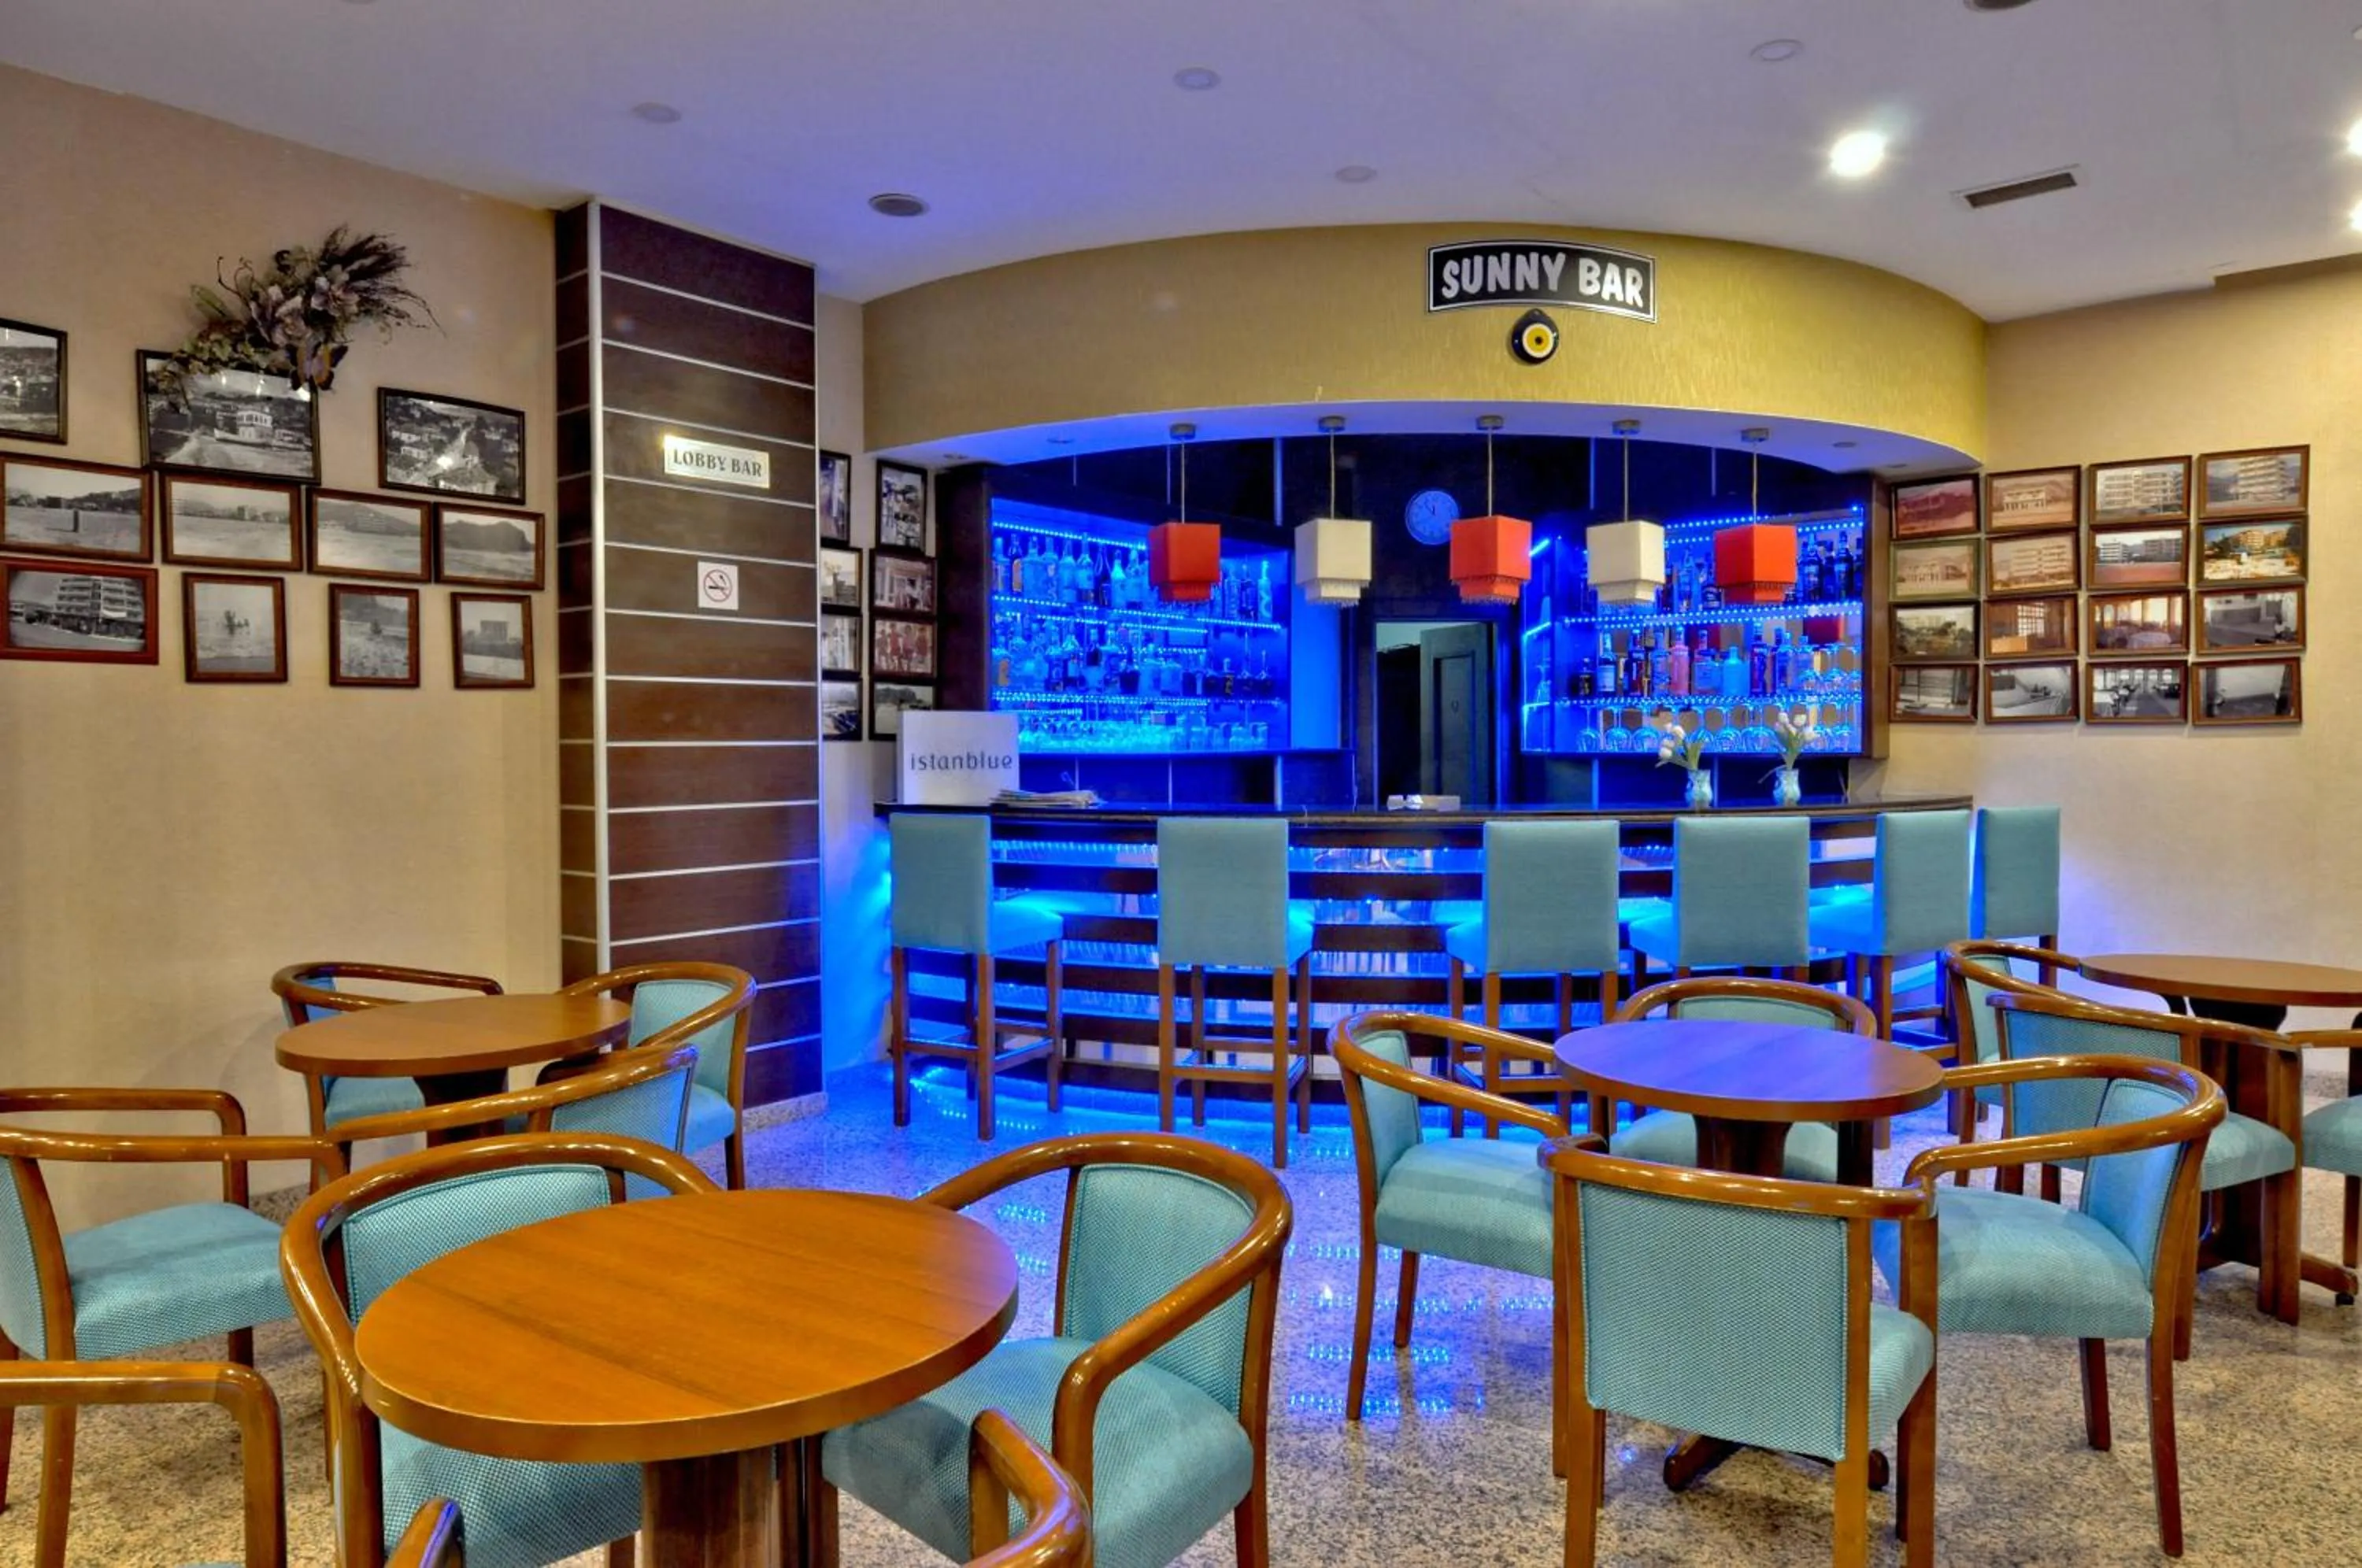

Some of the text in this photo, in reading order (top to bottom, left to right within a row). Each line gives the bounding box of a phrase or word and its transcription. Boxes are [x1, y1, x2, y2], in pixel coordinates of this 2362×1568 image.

[1442, 252, 1644, 309] SUNNY BAR
[673, 449, 762, 478] LOBBY BAR
[911, 751, 1013, 771] istanblue
